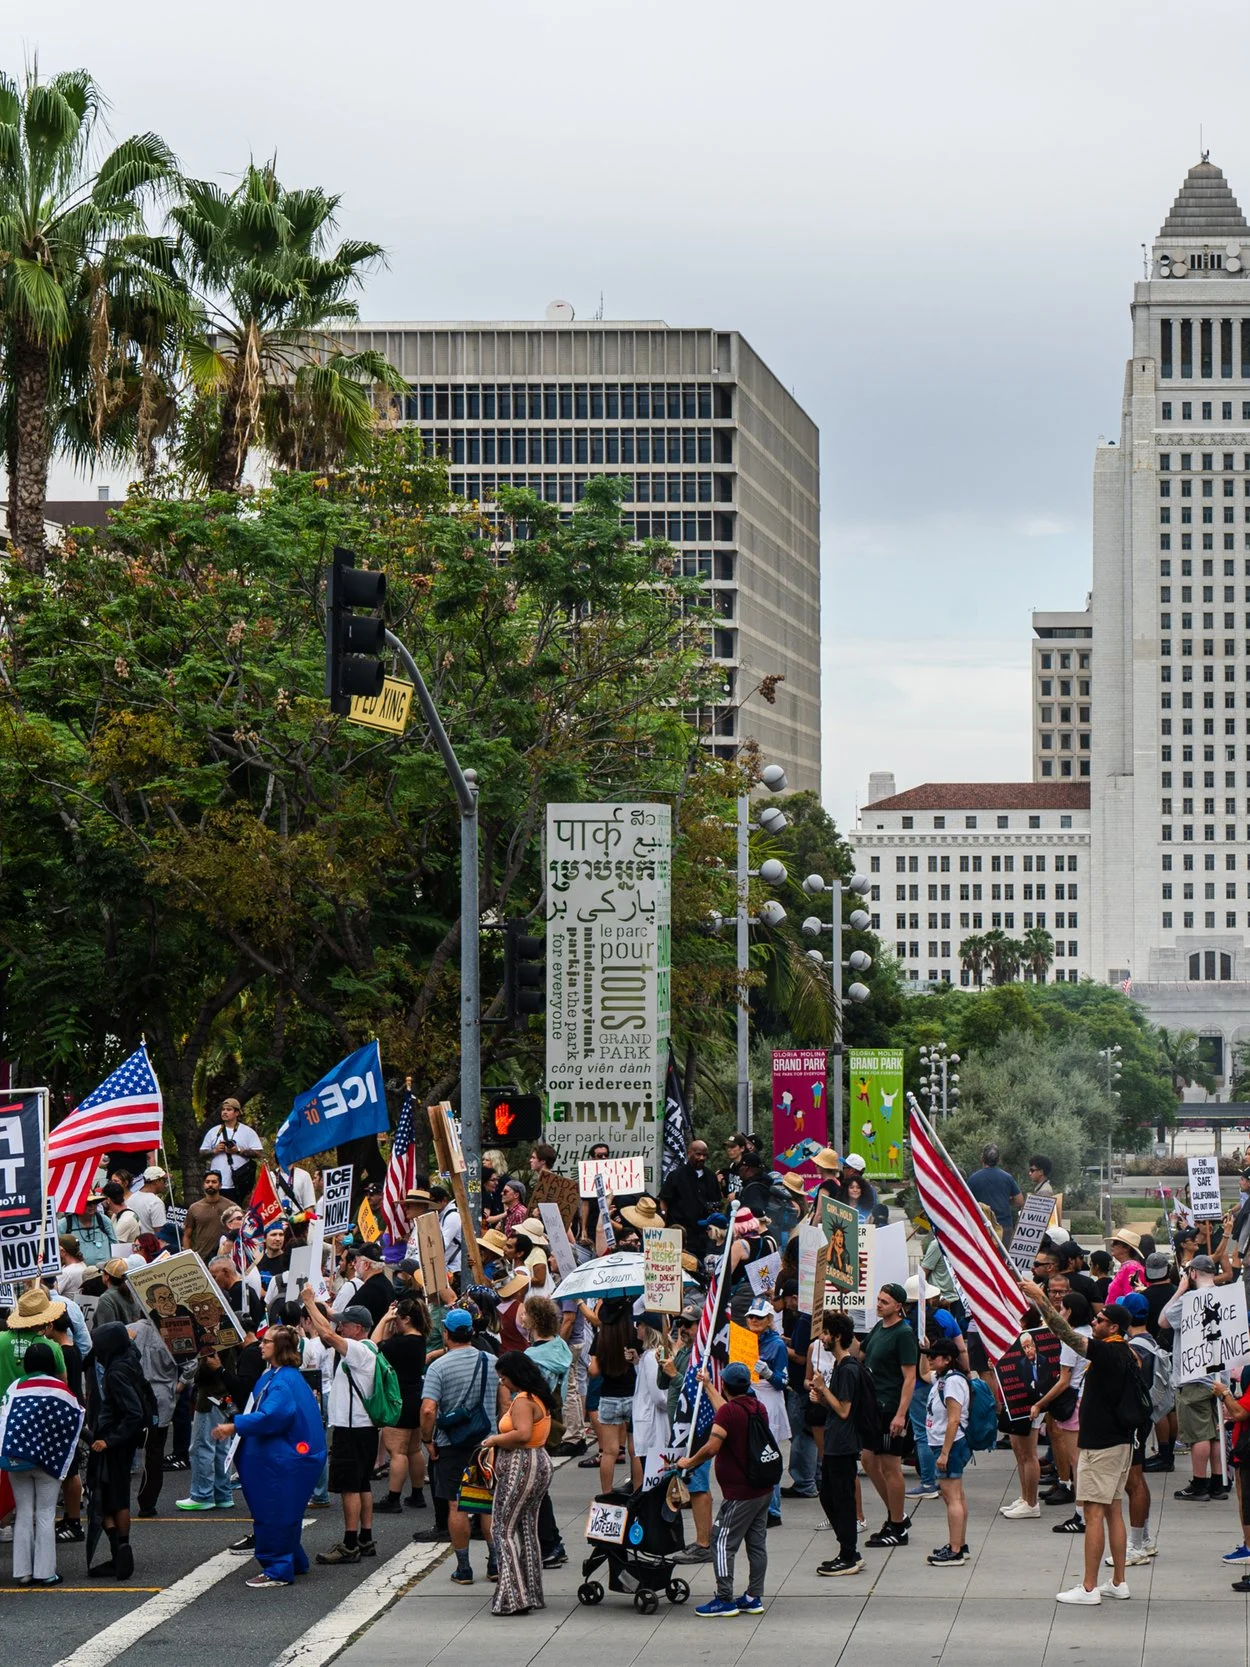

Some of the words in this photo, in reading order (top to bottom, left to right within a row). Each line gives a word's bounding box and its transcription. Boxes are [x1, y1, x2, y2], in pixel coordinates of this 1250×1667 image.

[379, 687, 406, 723] XING
[600, 924, 612, 937] le
[616, 927, 648, 940] parc
[552, 933, 565, 957] for
[601, 942, 654, 964] pour
[550, 962, 562, 1040] everyone
[600, 963, 653, 1030] tous
[567, 991, 579, 1018] the
[565, 1022, 579, 1060] park
[599, 1033, 652, 1045] GRAND
[600, 1046, 651, 1060] PARK
[551, 1063, 583, 1075] công
[588, 1062, 614, 1073] viên
[620, 1063, 651, 1073] dành
[773, 1059, 801, 1071] GRAND
[803, 1058, 826, 1071] PARK
[850, 1058, 879, 1070] GRAND
[880, 1057, 902, 1070] PARK
[579, 1077, 652, 1090] iedereen
[548, 1126, 573, 1143] der
[575, 1127, 605, 1146] park
[608, 1126, 627, 1143] für
[631, 1126, 655, 1143] alle
[326, 1168, 351, 1186] ICE
[469, 1167, 477, 1176] 2
[1192, 1167, 1215, 1175] OPERATION
[327, 1186, 350, 1200] OUT
[324, 1201, 348, 1228] NOW!
[1027, 1213, 1047, 1223] WILL
[1, 1220, 52, 1238] OUT
[644, 1229, 663, 1240] WHY
[1017, 1227, 1043, 1239] NOT
[2, 1237, 58, 1271] NOW!
[1011, 1242, 1038, 1253] ABIDE
[645, 1250, 651, 1261] I
[651, 1252, 680, 1263] RESPECT
[1007, 1256, 1032, 1269] EVIL
[846, 1263, 854, 1275] MY
[170, 1272, 188, 1283] WOULD
[186, 1270, 199, 1278] YOU
[645, 1273, 658, 1281] WHO
[825, 1265, 854, 1287] EARRINGS
[646, 1282, 675, 1293] RESPECT
[647, 1293, 664, 1306] ME?
[825, 1295, 865, 1306] FASCISM
[1193, 1293, 1213, 1313] OUR
[1181, 1305, 1237, 1335] EXISTNCE
[1181, 1331, 1250, 1376] RESISANCE
[760, 1451, 780, 1463] adidas
[645, 1476, 659, 1487] NO
[591, 1520, 605, 1533] VOTE
